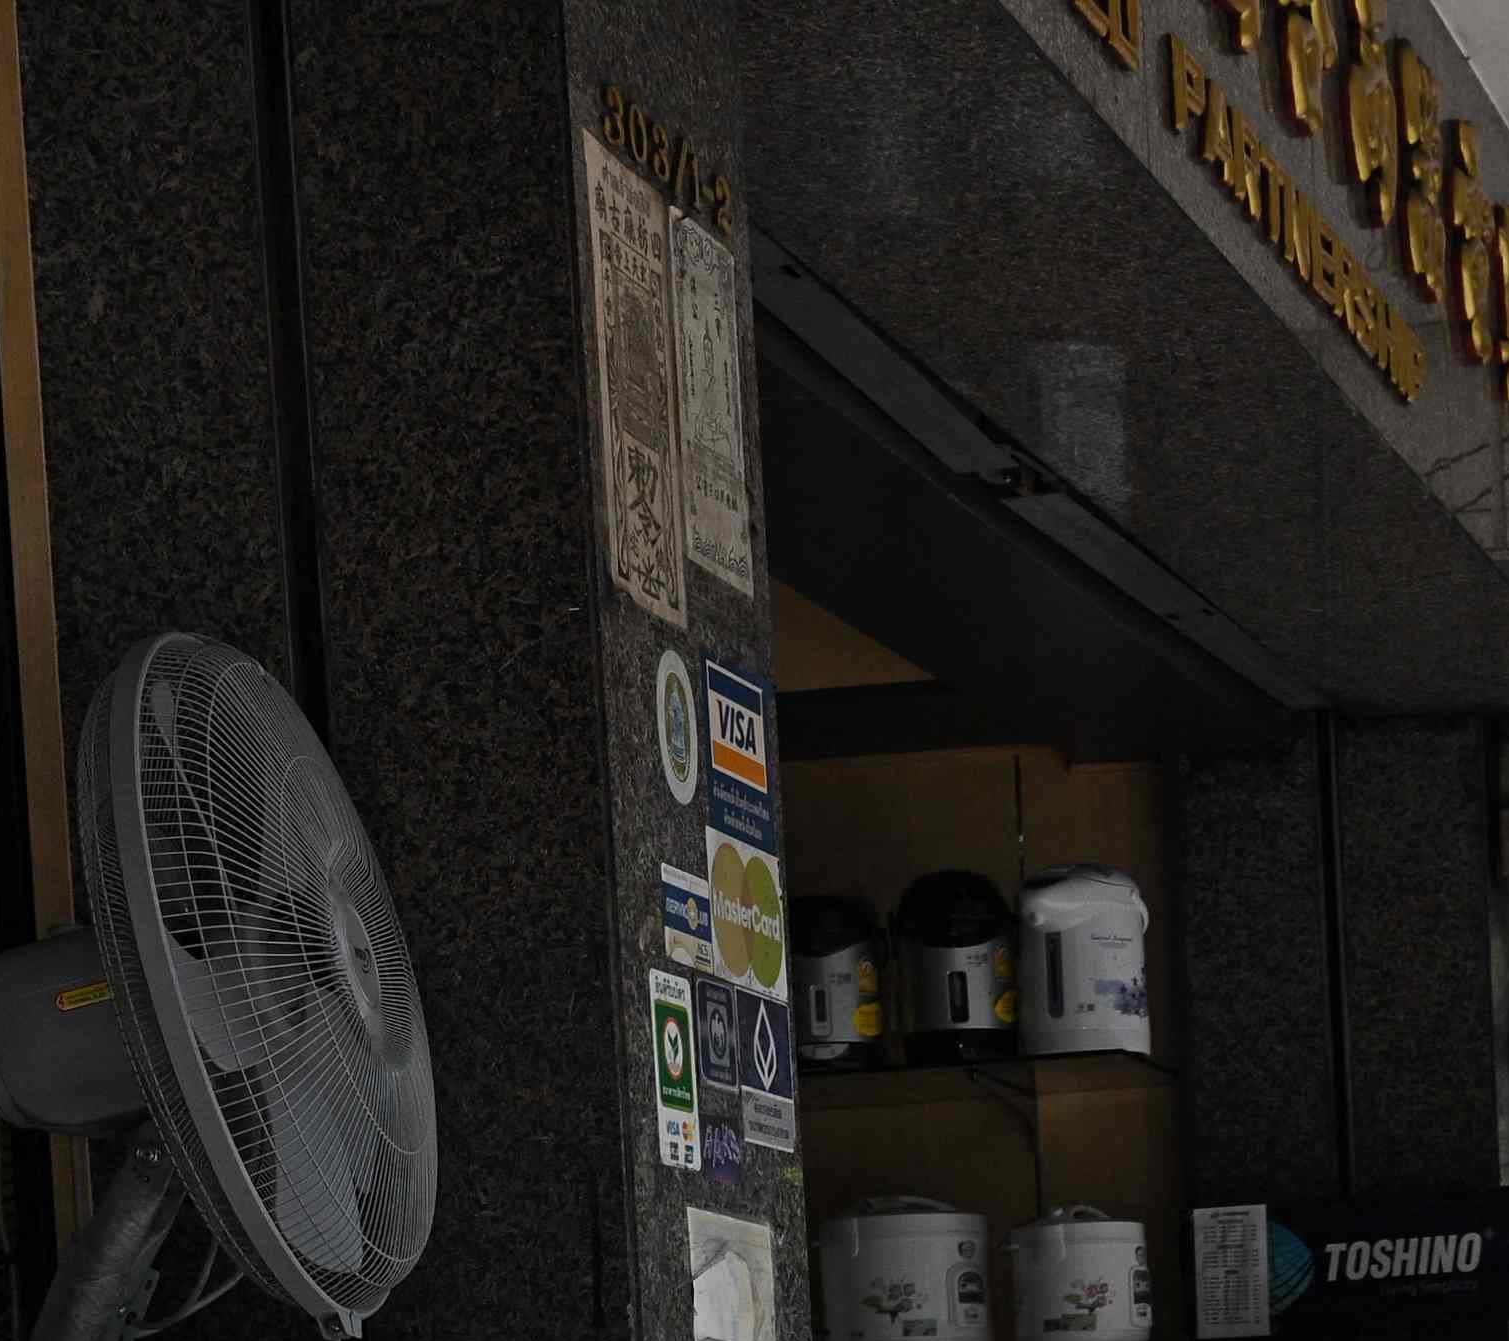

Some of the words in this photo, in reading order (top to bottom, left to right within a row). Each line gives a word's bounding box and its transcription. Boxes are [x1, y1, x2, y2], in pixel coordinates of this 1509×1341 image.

[717, 699, 757, 755] VISA
[713, 889, 781, 943] MasterCard
[1323, 1232, 1484, 1282] TOSHINO
